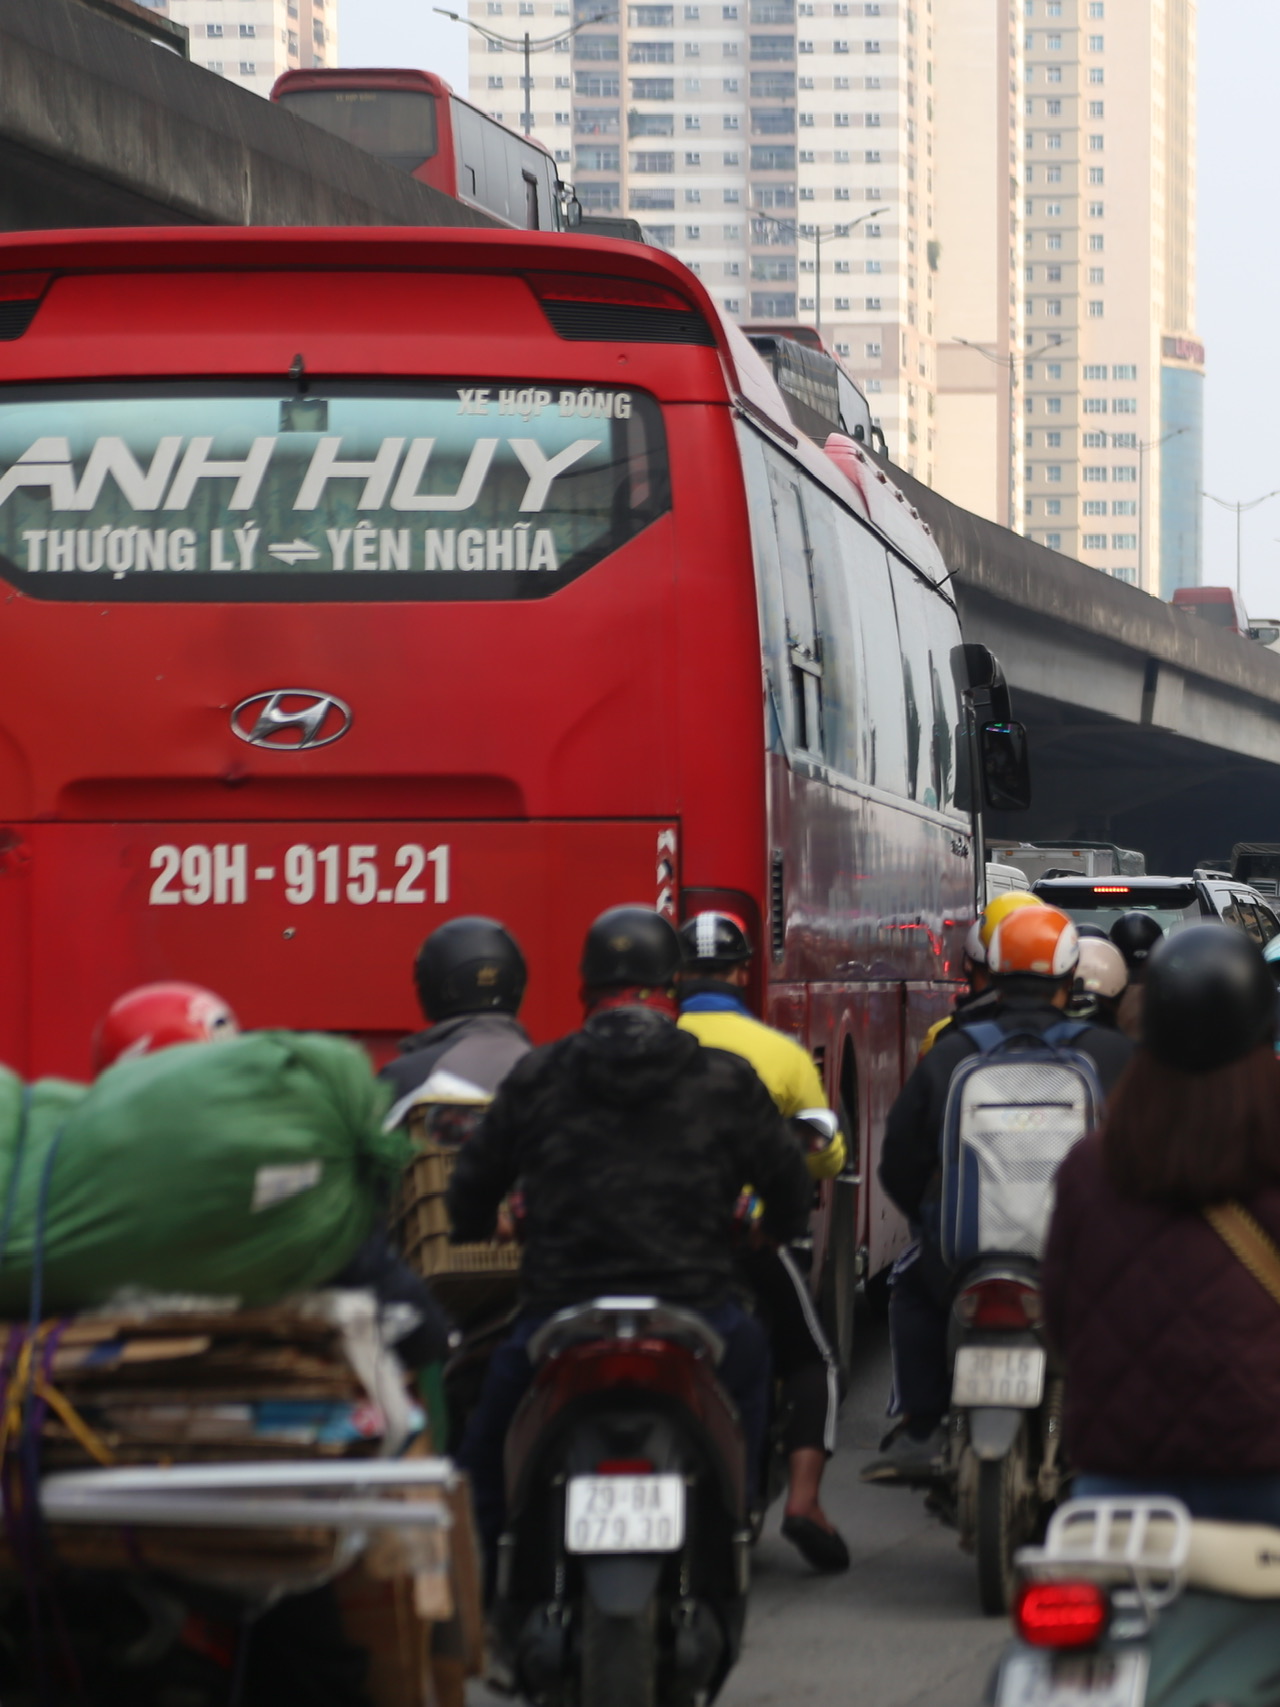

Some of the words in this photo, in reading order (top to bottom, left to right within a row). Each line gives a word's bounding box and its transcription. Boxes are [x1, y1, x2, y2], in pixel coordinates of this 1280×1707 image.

[456, 389, 491, 416] XE
[498, 387, 550, 422] HỢP
[558, 387, 632, 419] ĐỒNG
[0, 437, 277, 511] ANH
[292, 437, 602, 513] HUY
[22, 525, 197, 580] THƯỢNG
[210, 520, 261, 572] LÝ
[326, 520, 411, 572] YÊN
[424, 521, 558, 572] NGHĨA
